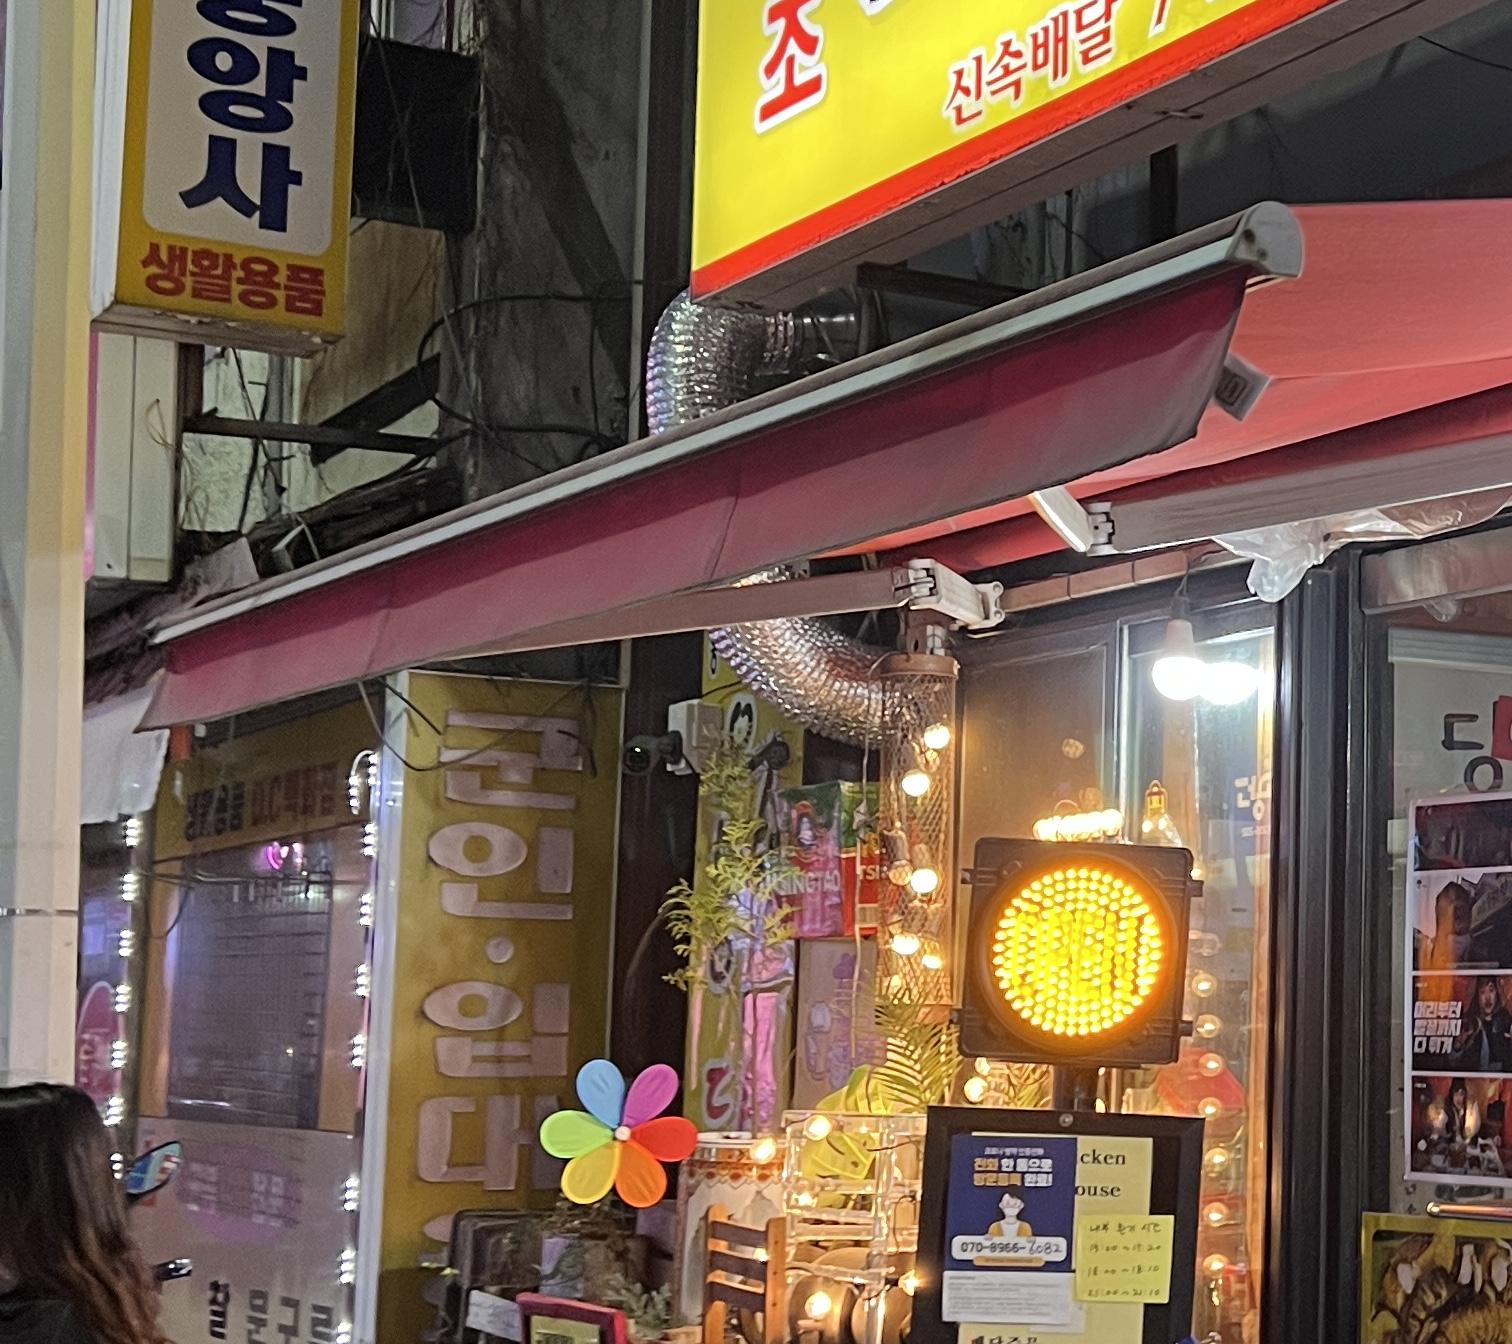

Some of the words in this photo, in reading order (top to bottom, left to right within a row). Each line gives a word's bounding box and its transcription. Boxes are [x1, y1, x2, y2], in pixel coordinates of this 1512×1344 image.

[140, 240, 326, 318] 생활용품
[1080, 1149, 1126, 1166] cken
[1074, 1184, 1122, 1199] ouse
